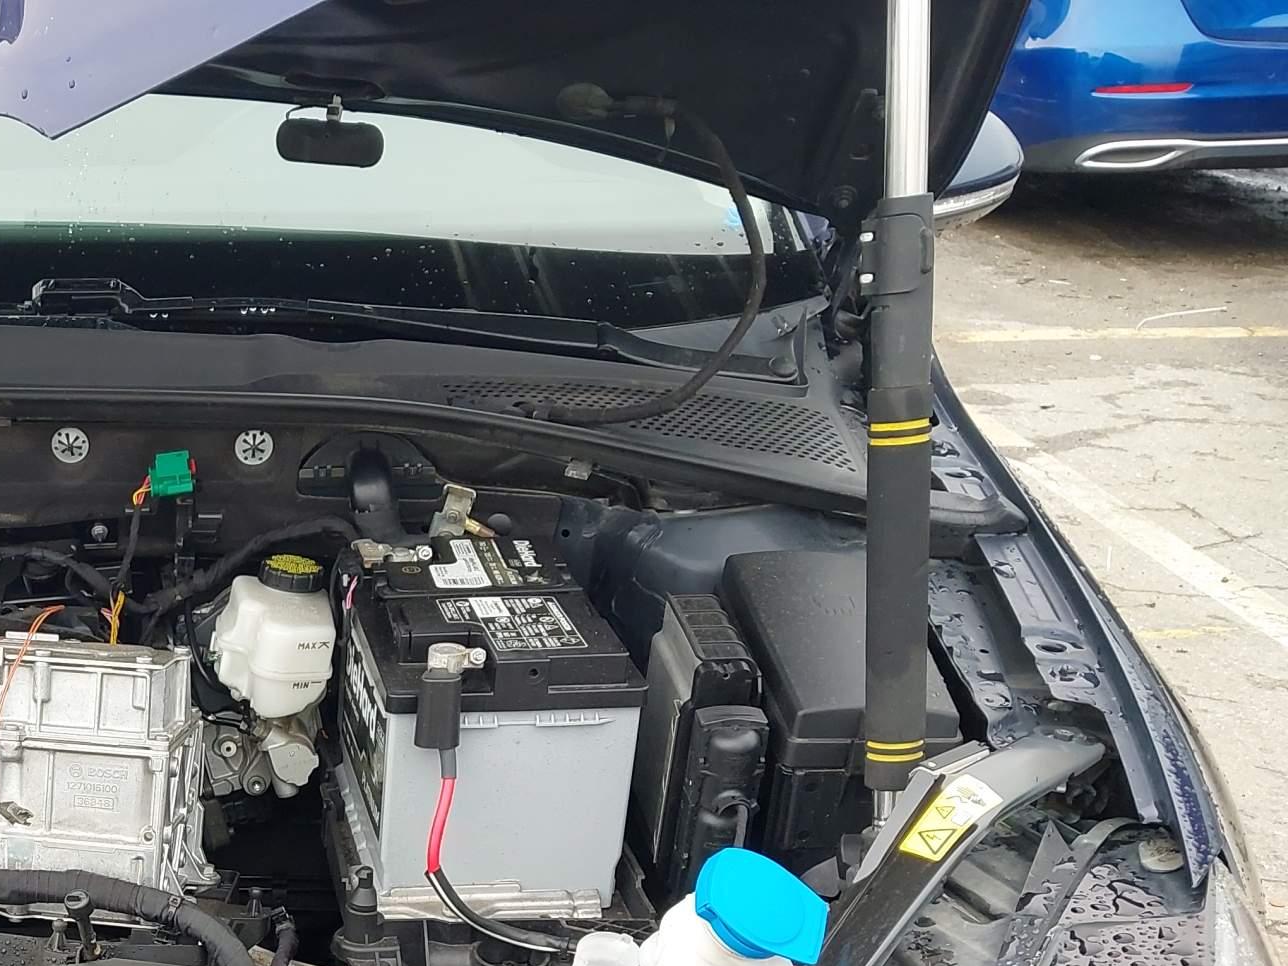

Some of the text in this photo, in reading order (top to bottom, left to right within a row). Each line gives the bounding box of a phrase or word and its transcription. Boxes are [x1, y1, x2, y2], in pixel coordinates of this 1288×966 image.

[512, 540, 543, 568] DieHard
[297, 641, 319, 650] MAX
[292, 681, 310, 690] MIN
[346, 639, 378, 745] DieHard
[87, 766, 129, 781] BOSCH
